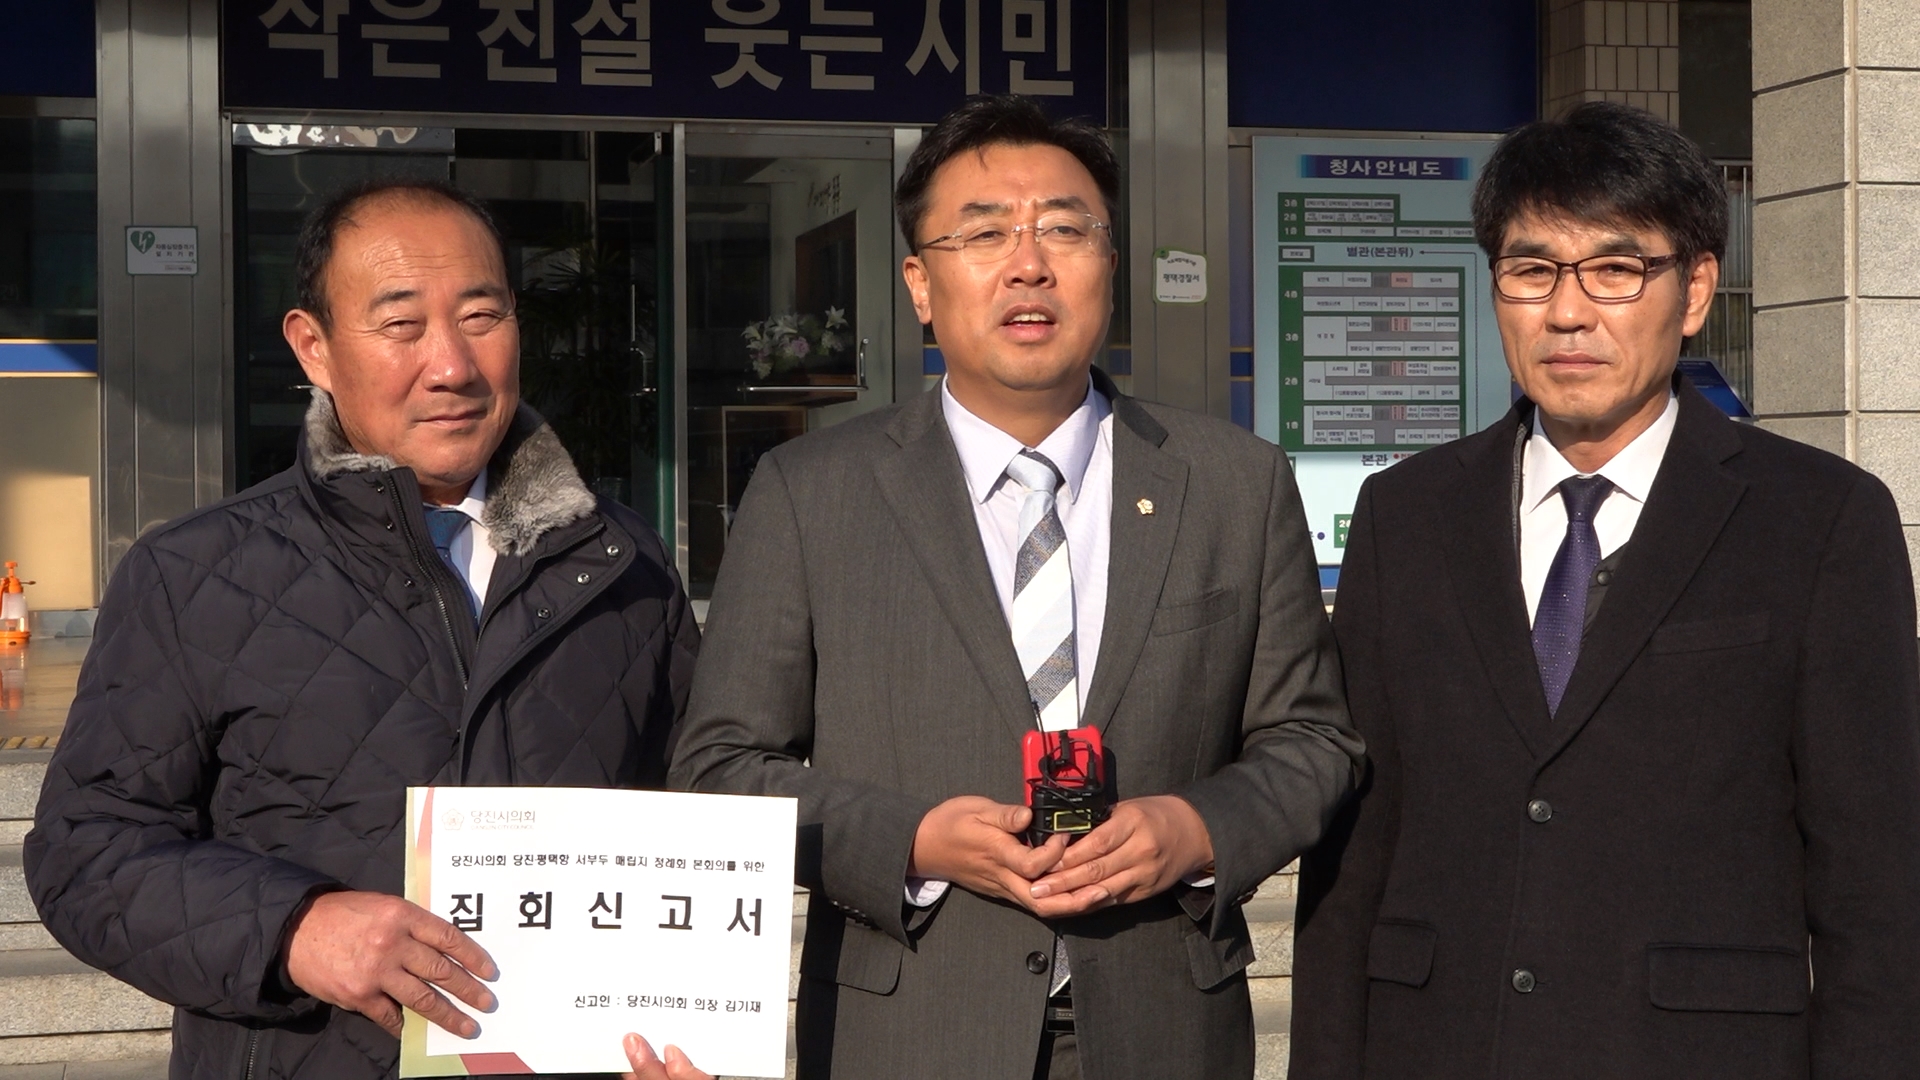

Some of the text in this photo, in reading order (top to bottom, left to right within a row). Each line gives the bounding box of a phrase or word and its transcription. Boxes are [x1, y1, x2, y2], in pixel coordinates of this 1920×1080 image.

[1329, 159, 1442, 177] 청사안내도
[1346, 246, 1414, 258] 별관(본관뒤)
[1361, 453, 1389, 467] 본관
[470, 810, 536, 824] 당진시의회
[451, 854, 507, 868] 당진시의회
[575, 853, 609, 866] 서부두
[615, 854, 648, 867] 매립지
[654, 856, 687, 870] 정례회
[693, 858, 736, 872] 본회의를
[743, 860, 765, 873] 위한
[574, 994, 611, 1009] 신고인
[627, 994, 688, 1010] 당진시의회
[694, 997, 719, 1012] 의장
[725, 999, 762, 1013] 김기재
